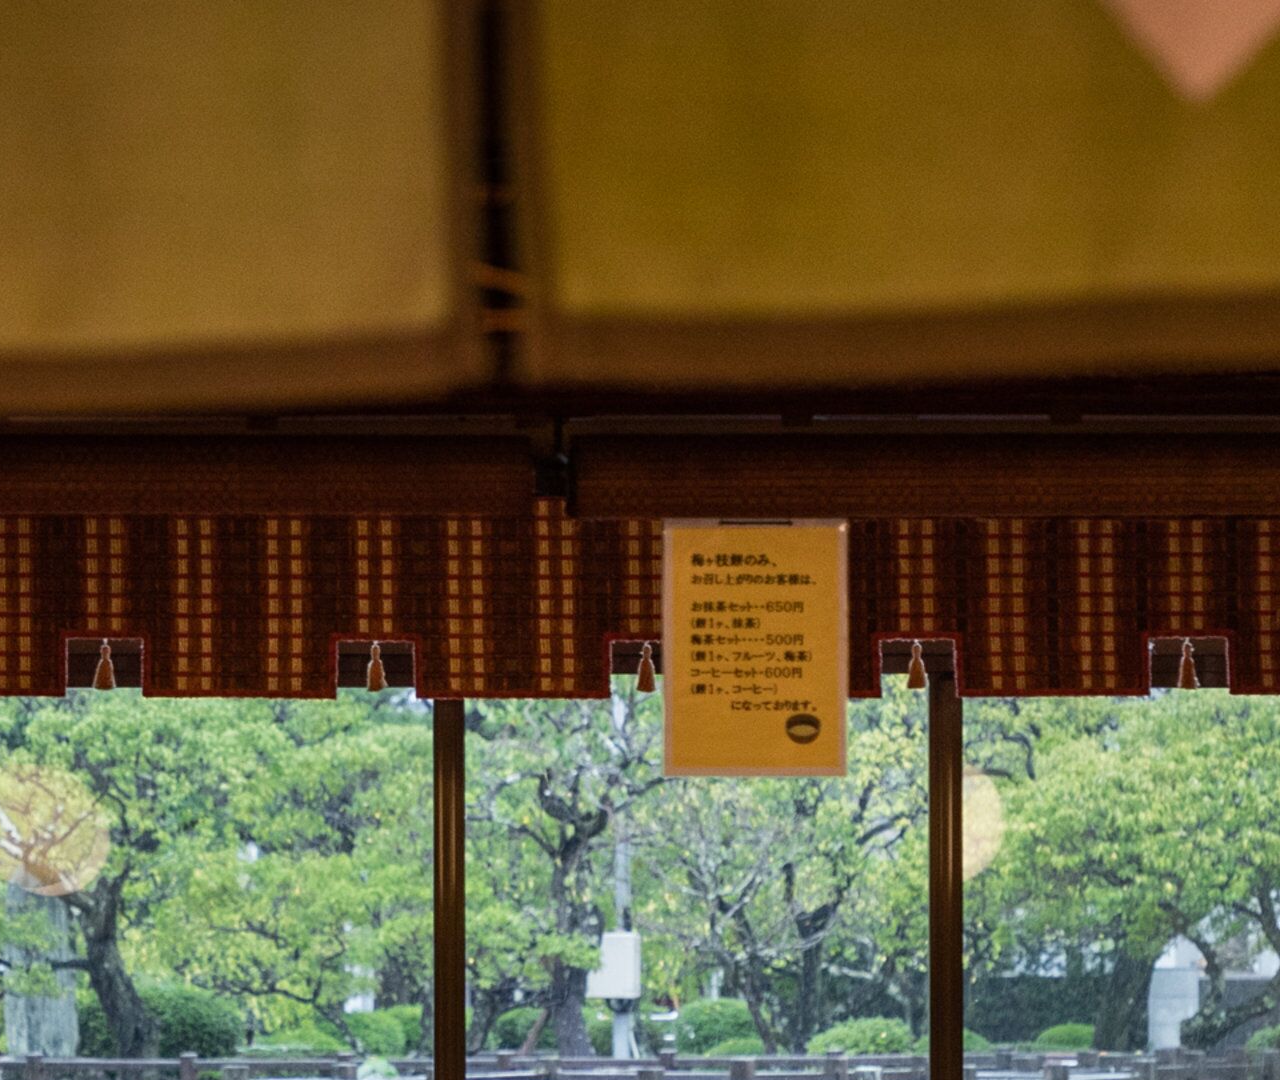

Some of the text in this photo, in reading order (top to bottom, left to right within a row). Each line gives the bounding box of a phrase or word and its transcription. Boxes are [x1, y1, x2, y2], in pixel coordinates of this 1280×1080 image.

[730, 700, 818, 712] になっております。
